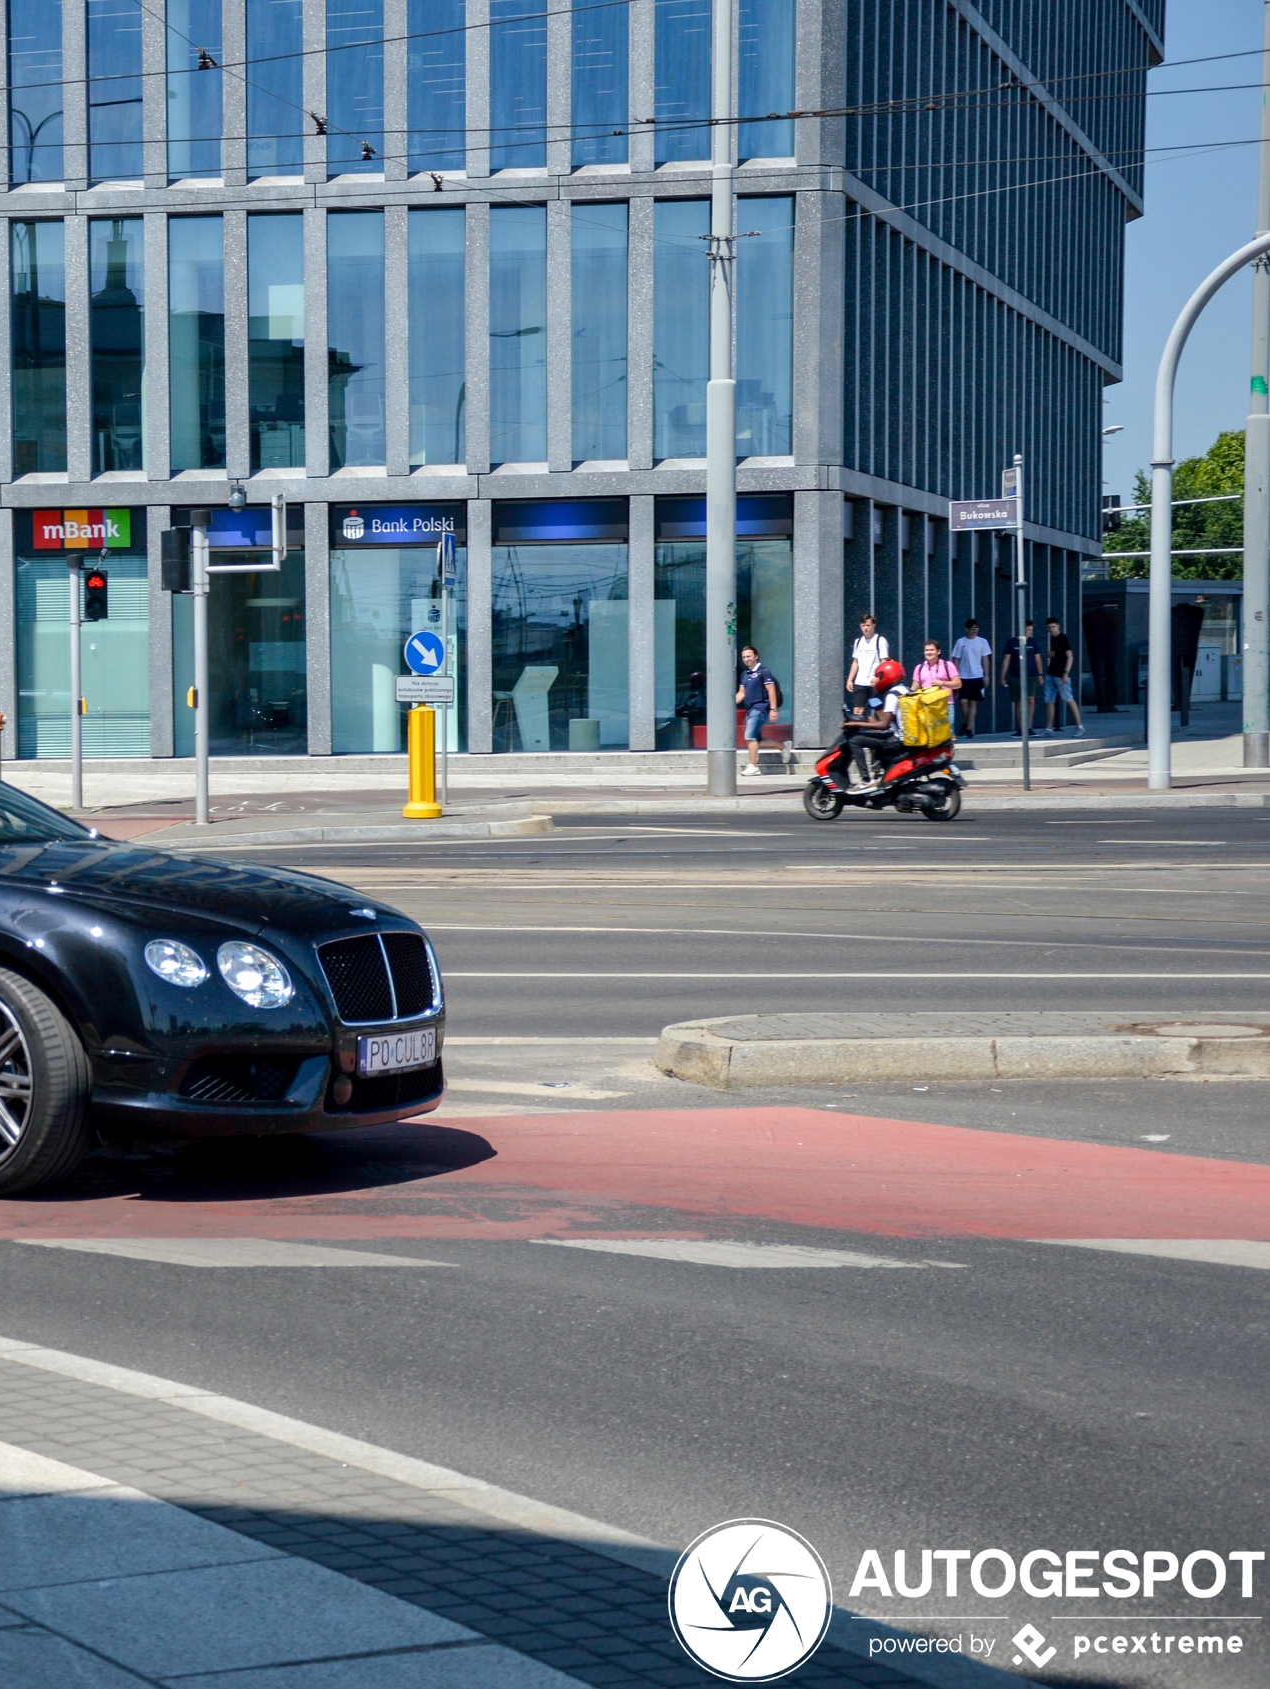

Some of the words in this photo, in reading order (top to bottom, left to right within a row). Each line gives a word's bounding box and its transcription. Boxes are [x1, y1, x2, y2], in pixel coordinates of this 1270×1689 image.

[960, 509, 1008, 520] Bukowska
[42, 519, 120, 540] mBank
[372, 518, 408, 533] Bank
[413, 517, 454, 532] Polski
[395, 1032, 435, 1065] CUL8R
